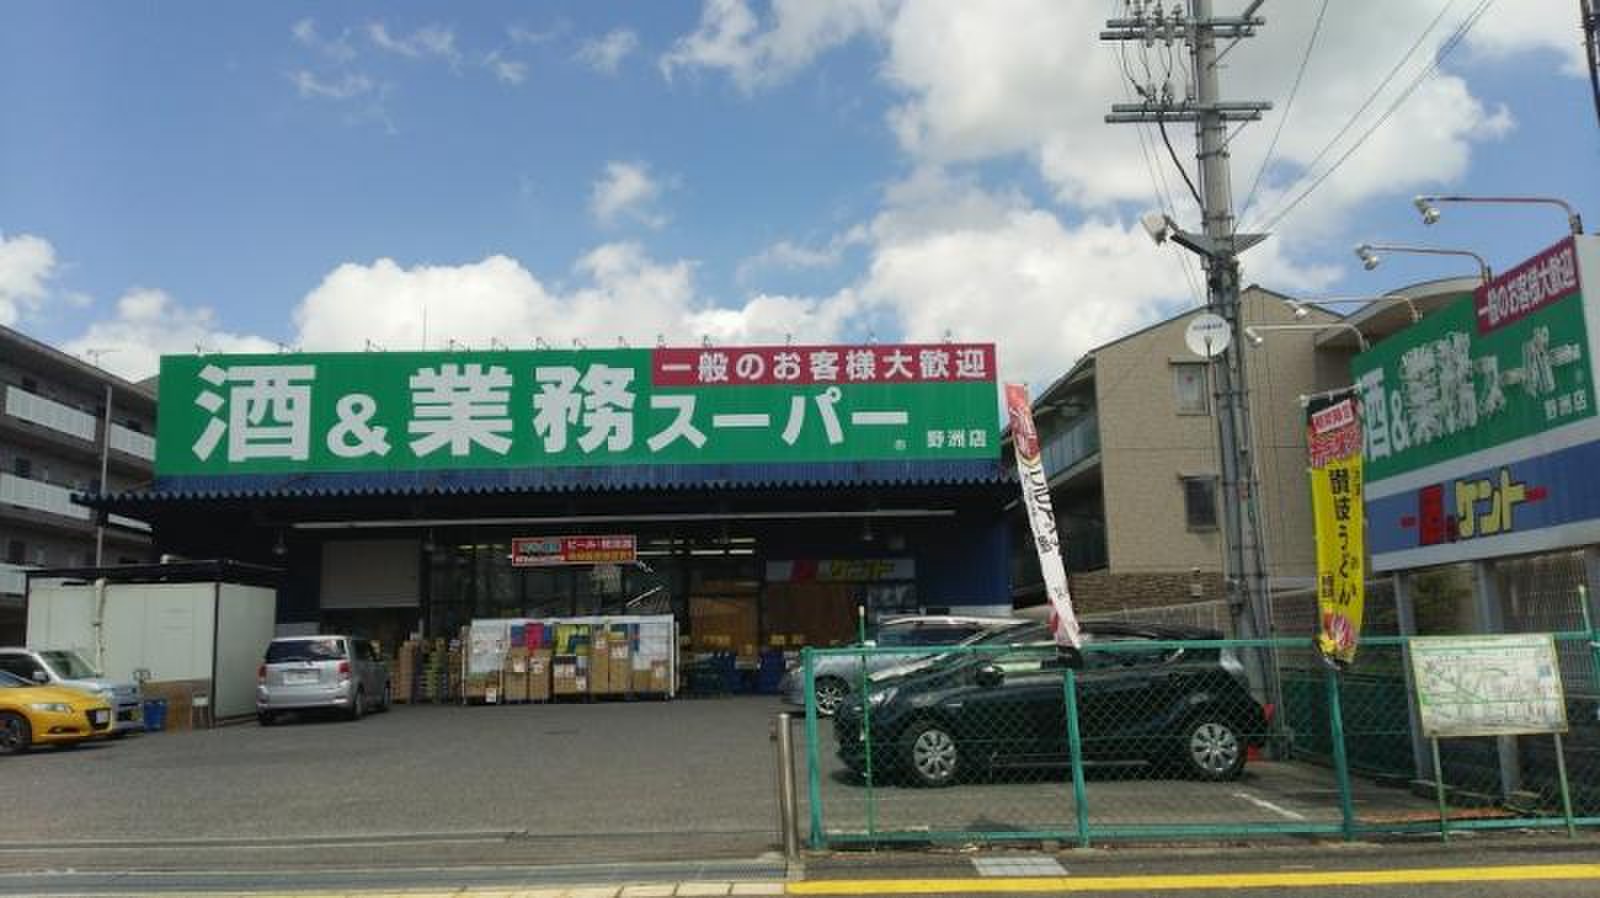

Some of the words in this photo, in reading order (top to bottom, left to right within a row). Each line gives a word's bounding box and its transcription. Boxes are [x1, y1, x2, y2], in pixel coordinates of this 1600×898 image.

[660, 349, 987, 382] 一般のお客様大歓迎
[191, 363, 908, 463] 酒&業務スーパー
[926, 429, 987, 449] 野洲店
